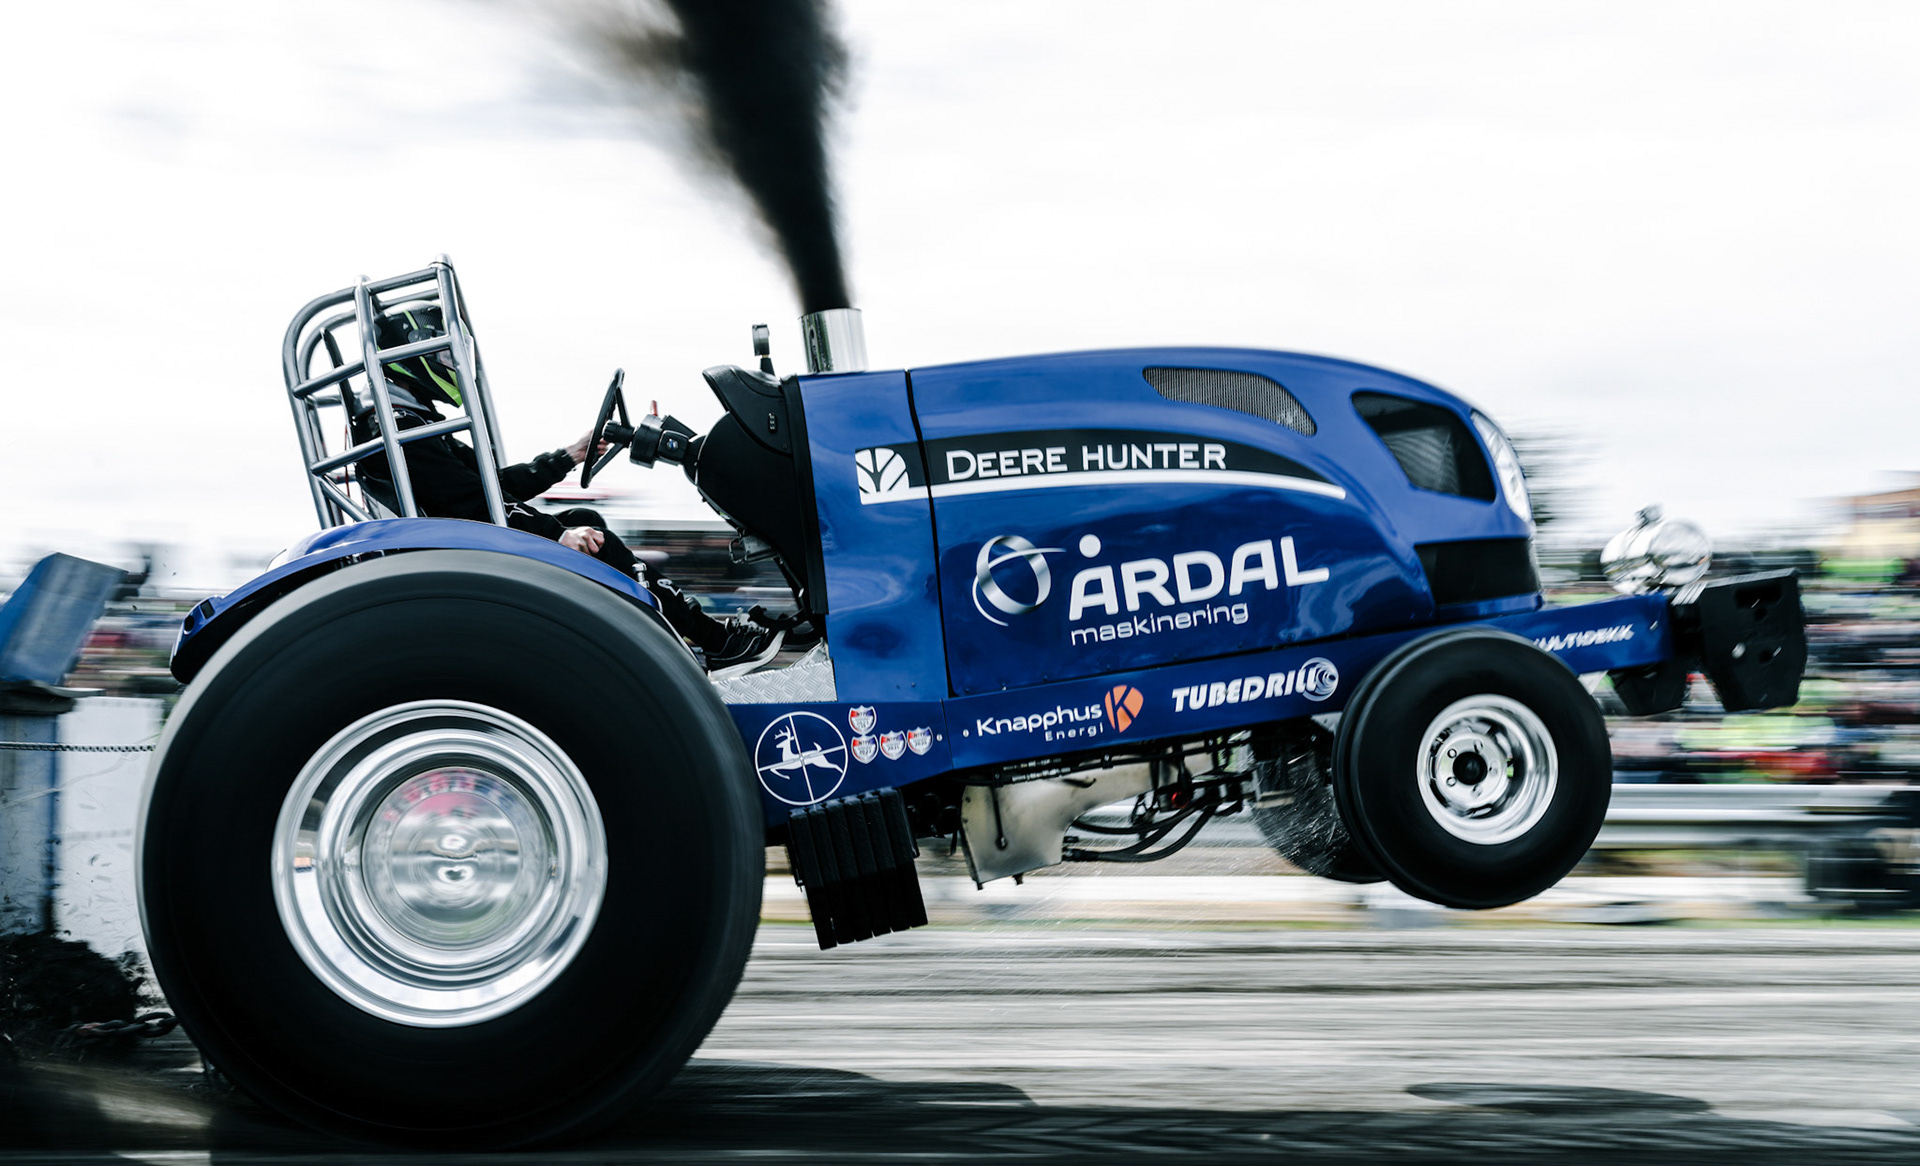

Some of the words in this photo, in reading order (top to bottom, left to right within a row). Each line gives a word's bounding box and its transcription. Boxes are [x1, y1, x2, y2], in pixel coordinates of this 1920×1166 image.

[946, 446, 1068, 481] DEERE
[1082, 443, 1227, 471] HUNTER
[1069, 534, 1330, 621] ÅRDAL
[1070, 602, 1249, 646] maskinering
[1533, 623, 1635, 653] ULTIDEKK
[1171, 667, 1319, 713] TUBEDRILL
[976, 703, 1103, 737] Knapphus
[1044, 722, 1104, 742] Energi
